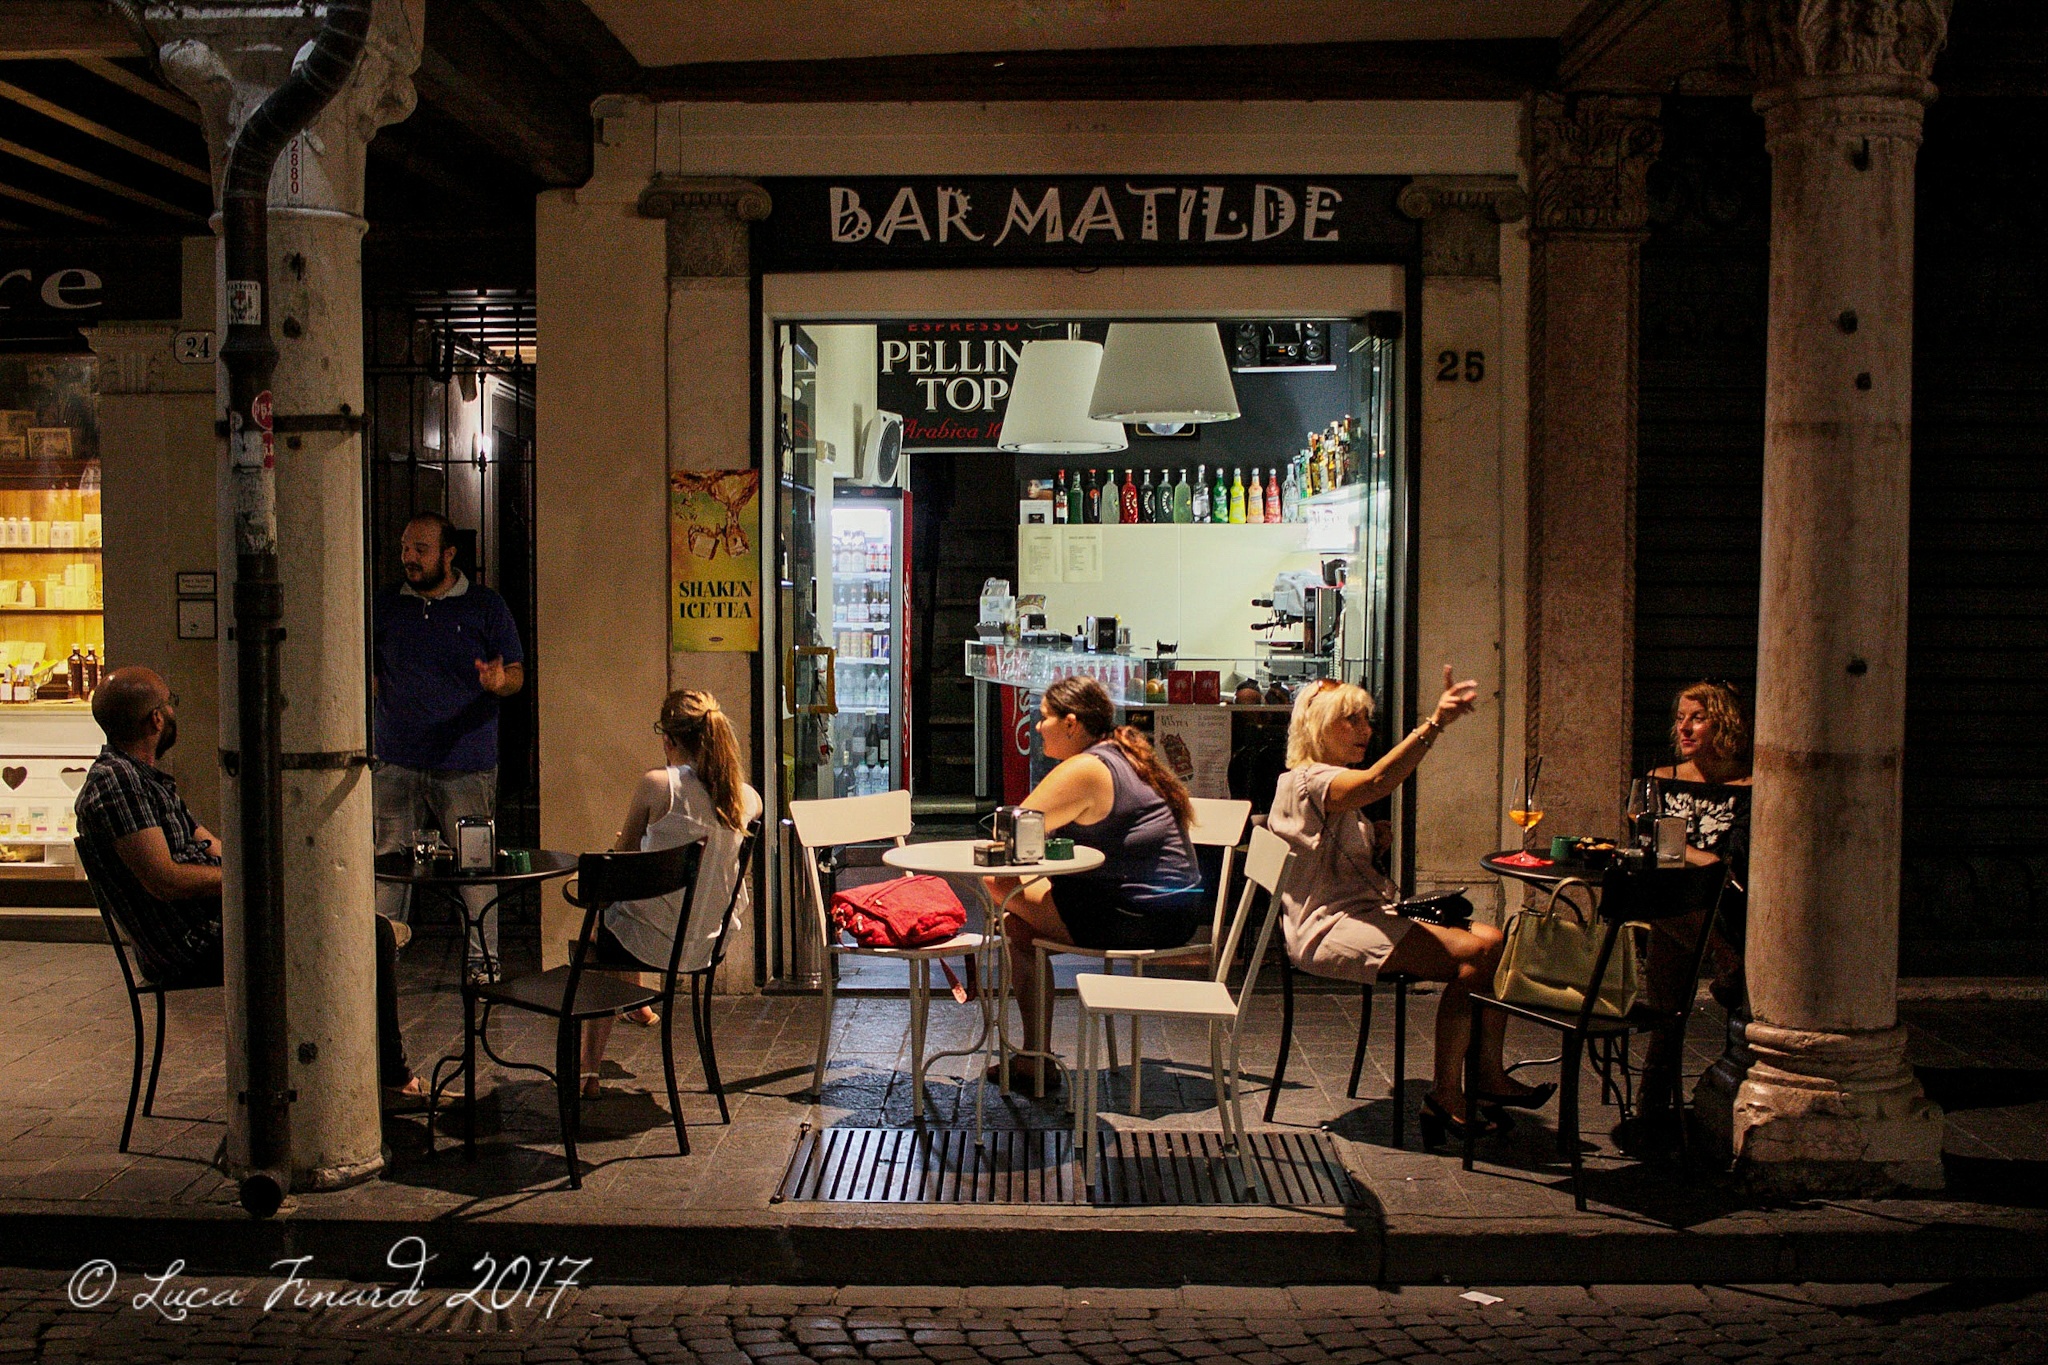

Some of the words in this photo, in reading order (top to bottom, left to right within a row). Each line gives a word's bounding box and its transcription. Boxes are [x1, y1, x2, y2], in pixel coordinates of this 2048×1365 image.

[290, 140, 299, 194] 2880
[829, 186, 985, 244] BAR
[993, 182, 1342, 246] MATILDE
[185, 335, 209, 358] 24
[1437, 350, 1484, 382] 25
[916, 377, 1011, 412] TOP
[903, 417, 979, 439] Arabica
[679, 581, 752, 598] SHAKEN
[679, 602, 711, 619] ICE
[713, 602, 752, 619] TEA
